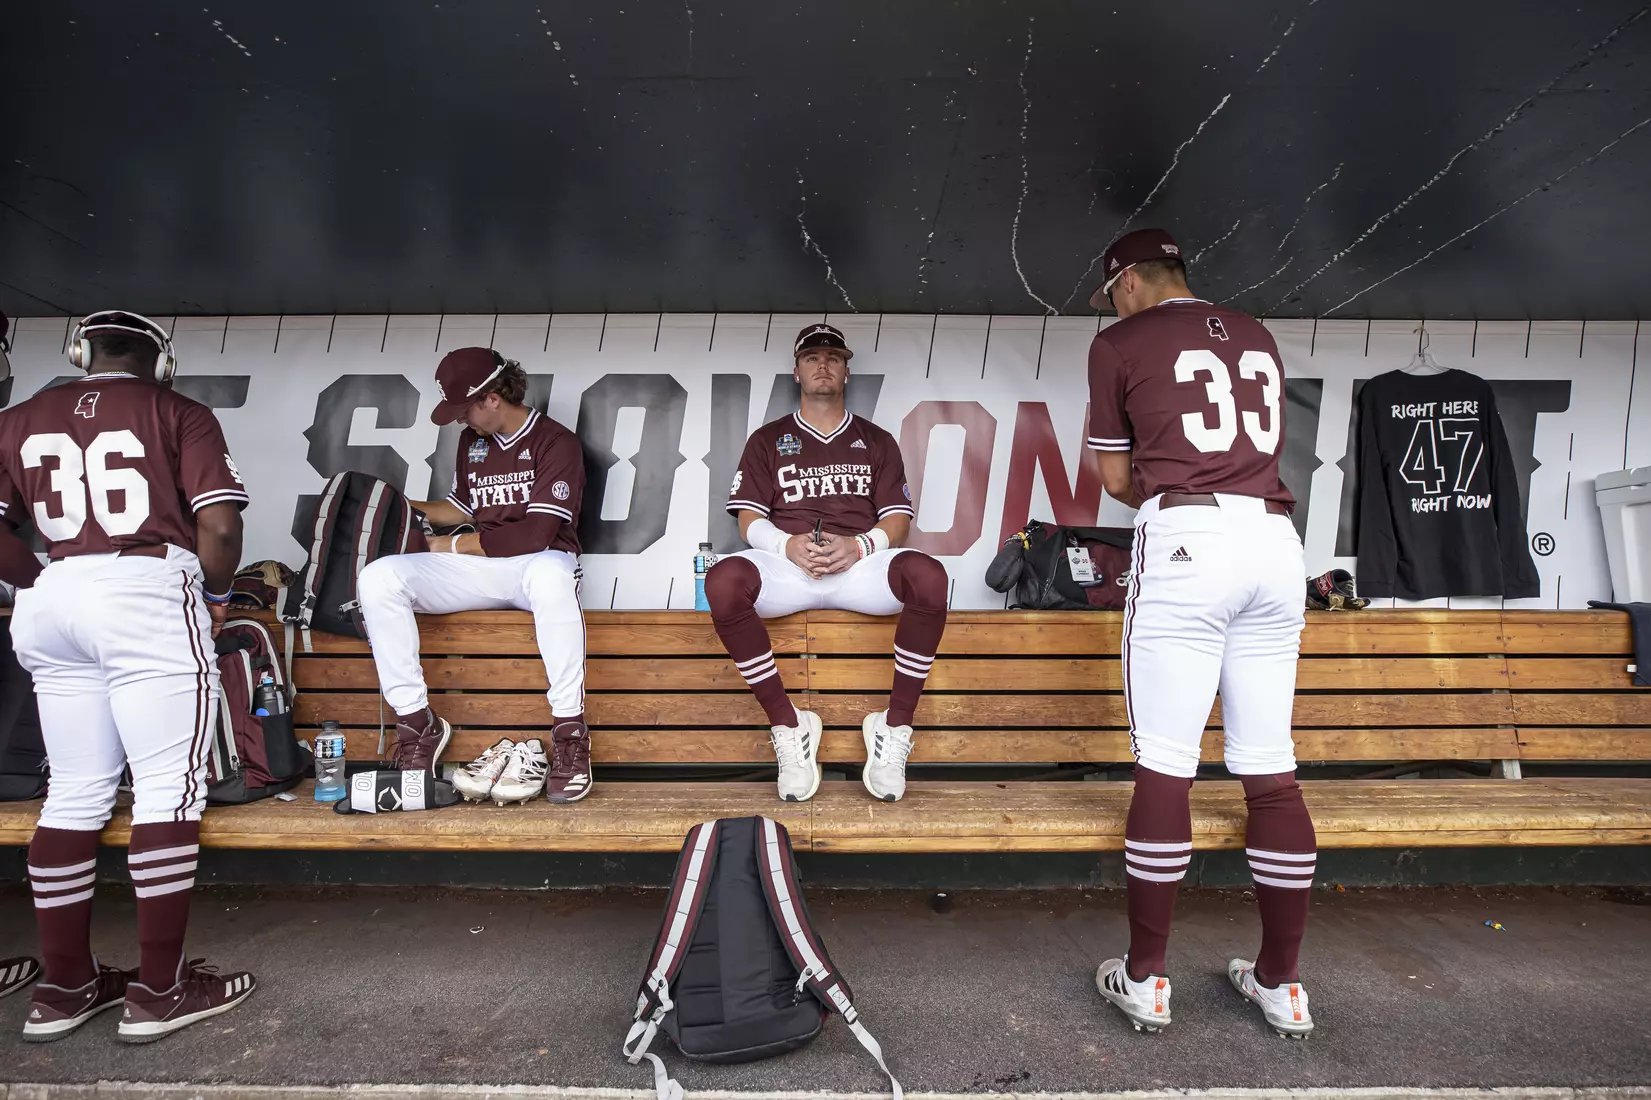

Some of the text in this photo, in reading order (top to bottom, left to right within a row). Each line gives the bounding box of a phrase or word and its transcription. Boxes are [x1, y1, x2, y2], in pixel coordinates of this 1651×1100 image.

[1173, 349, 1281, 455] 33
[1391, 400, 1479, 419] RIGHT HERE
[797, 464, 872, 477] MISSISSIPPI
[1399, 417, 1484, 494] 47
[20, 429, 150, 541] 36
[777, 464, 872, 503] STATE
[1411, 494, 1492, 513] RIGHT NOW
